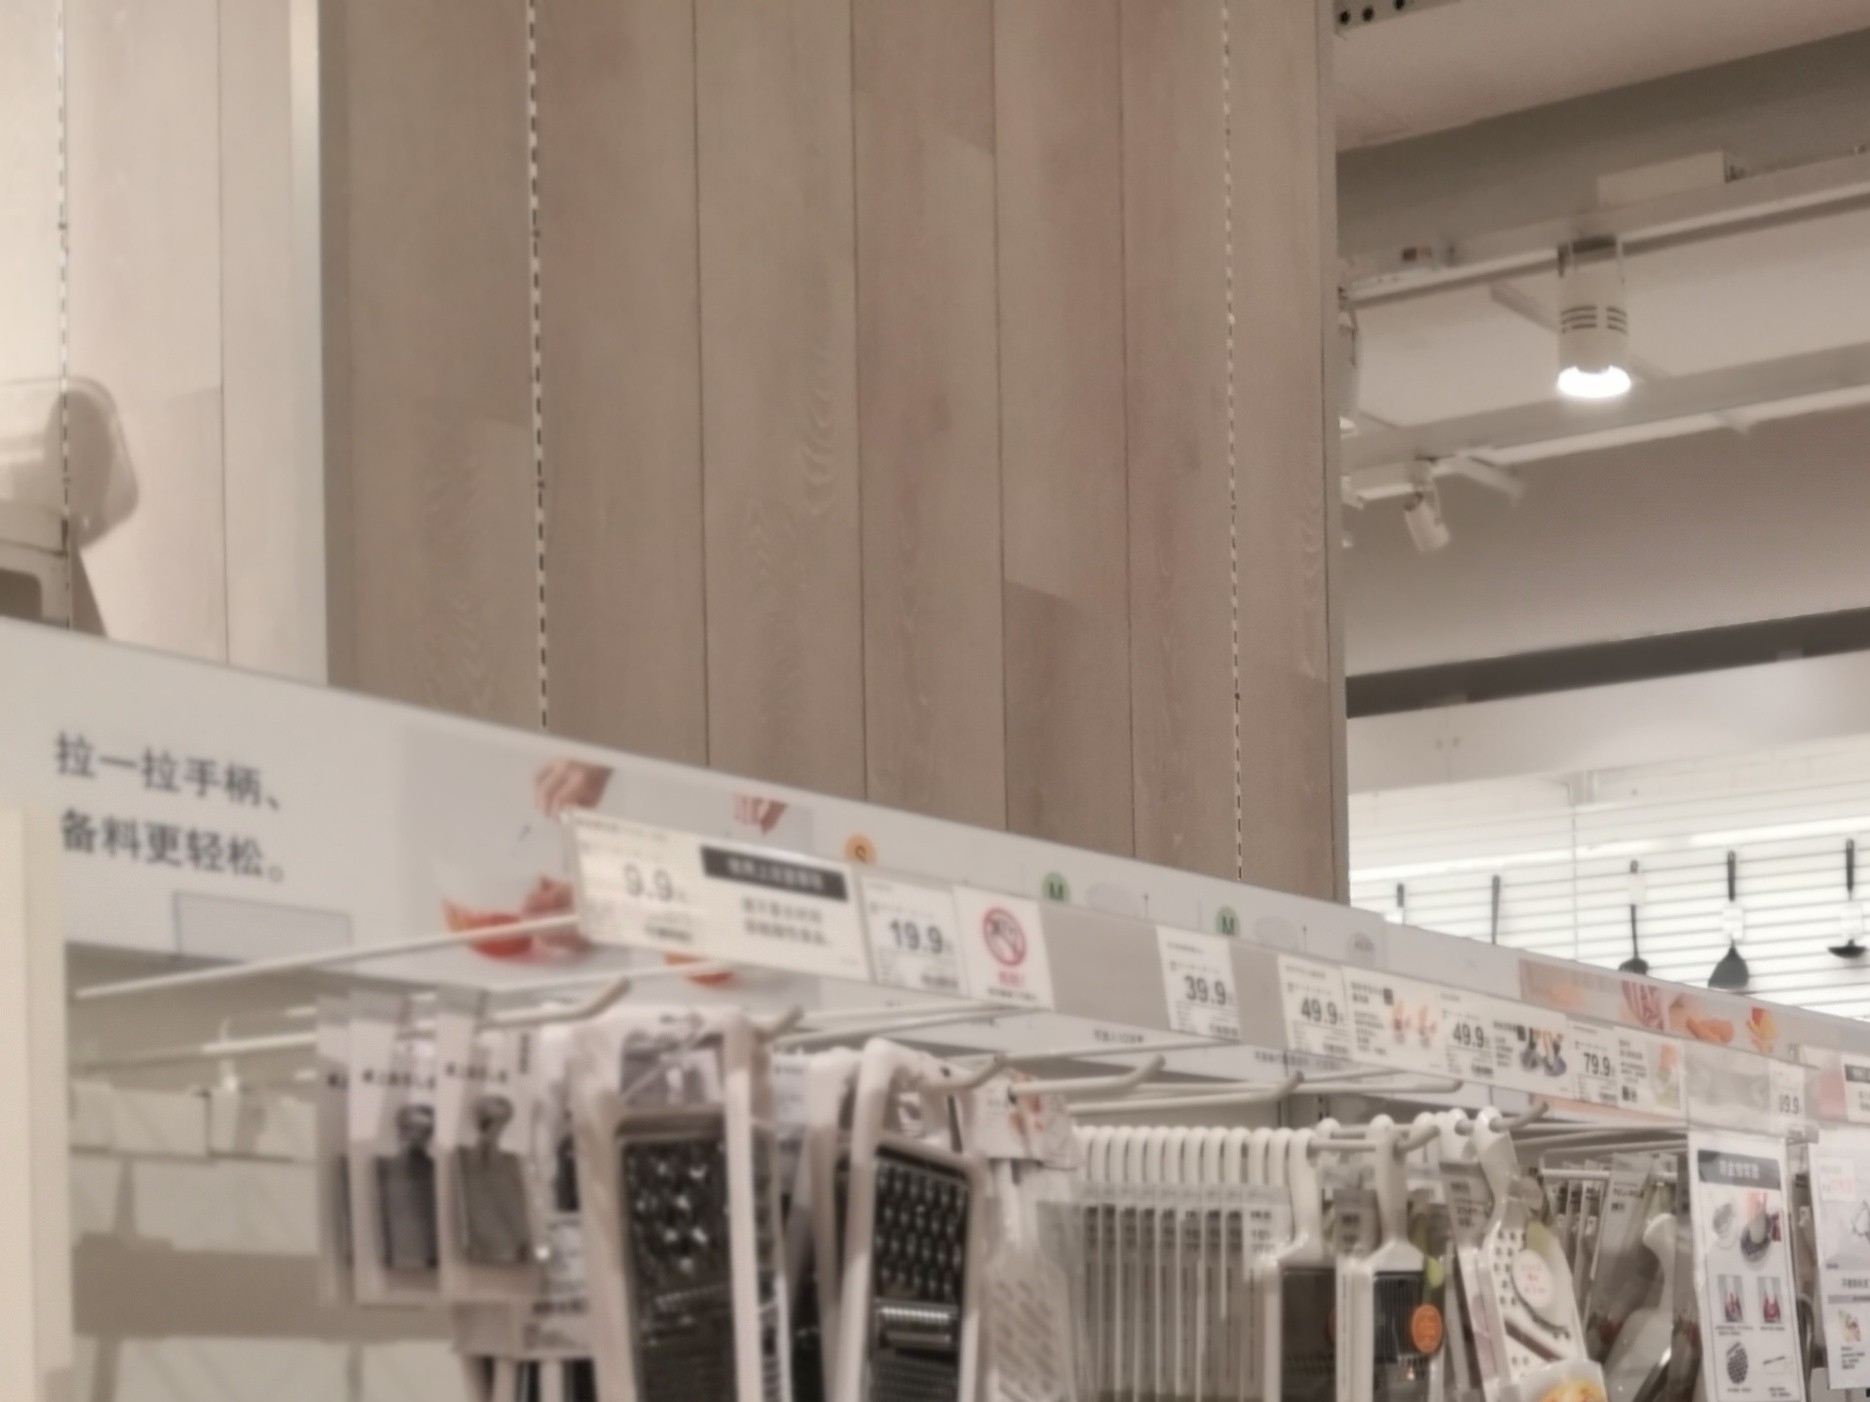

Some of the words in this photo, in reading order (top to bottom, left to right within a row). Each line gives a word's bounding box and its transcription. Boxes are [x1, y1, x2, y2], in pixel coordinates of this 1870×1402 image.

[55, 730, 281, 812] 拉一拉手柄、
[61, 807, 287, 884] 备料更轻松。
[1049, 882, 1065, 902] M
[1221, 915, 1236, 935] M
[1184, 975, 1227, 1006] 39.9
[1301, 997, 1338, 1025] 49.9
[1453, 1022, 1484, 1048] 49.9
[1583, 1051, 1612, 1077] 79.9
